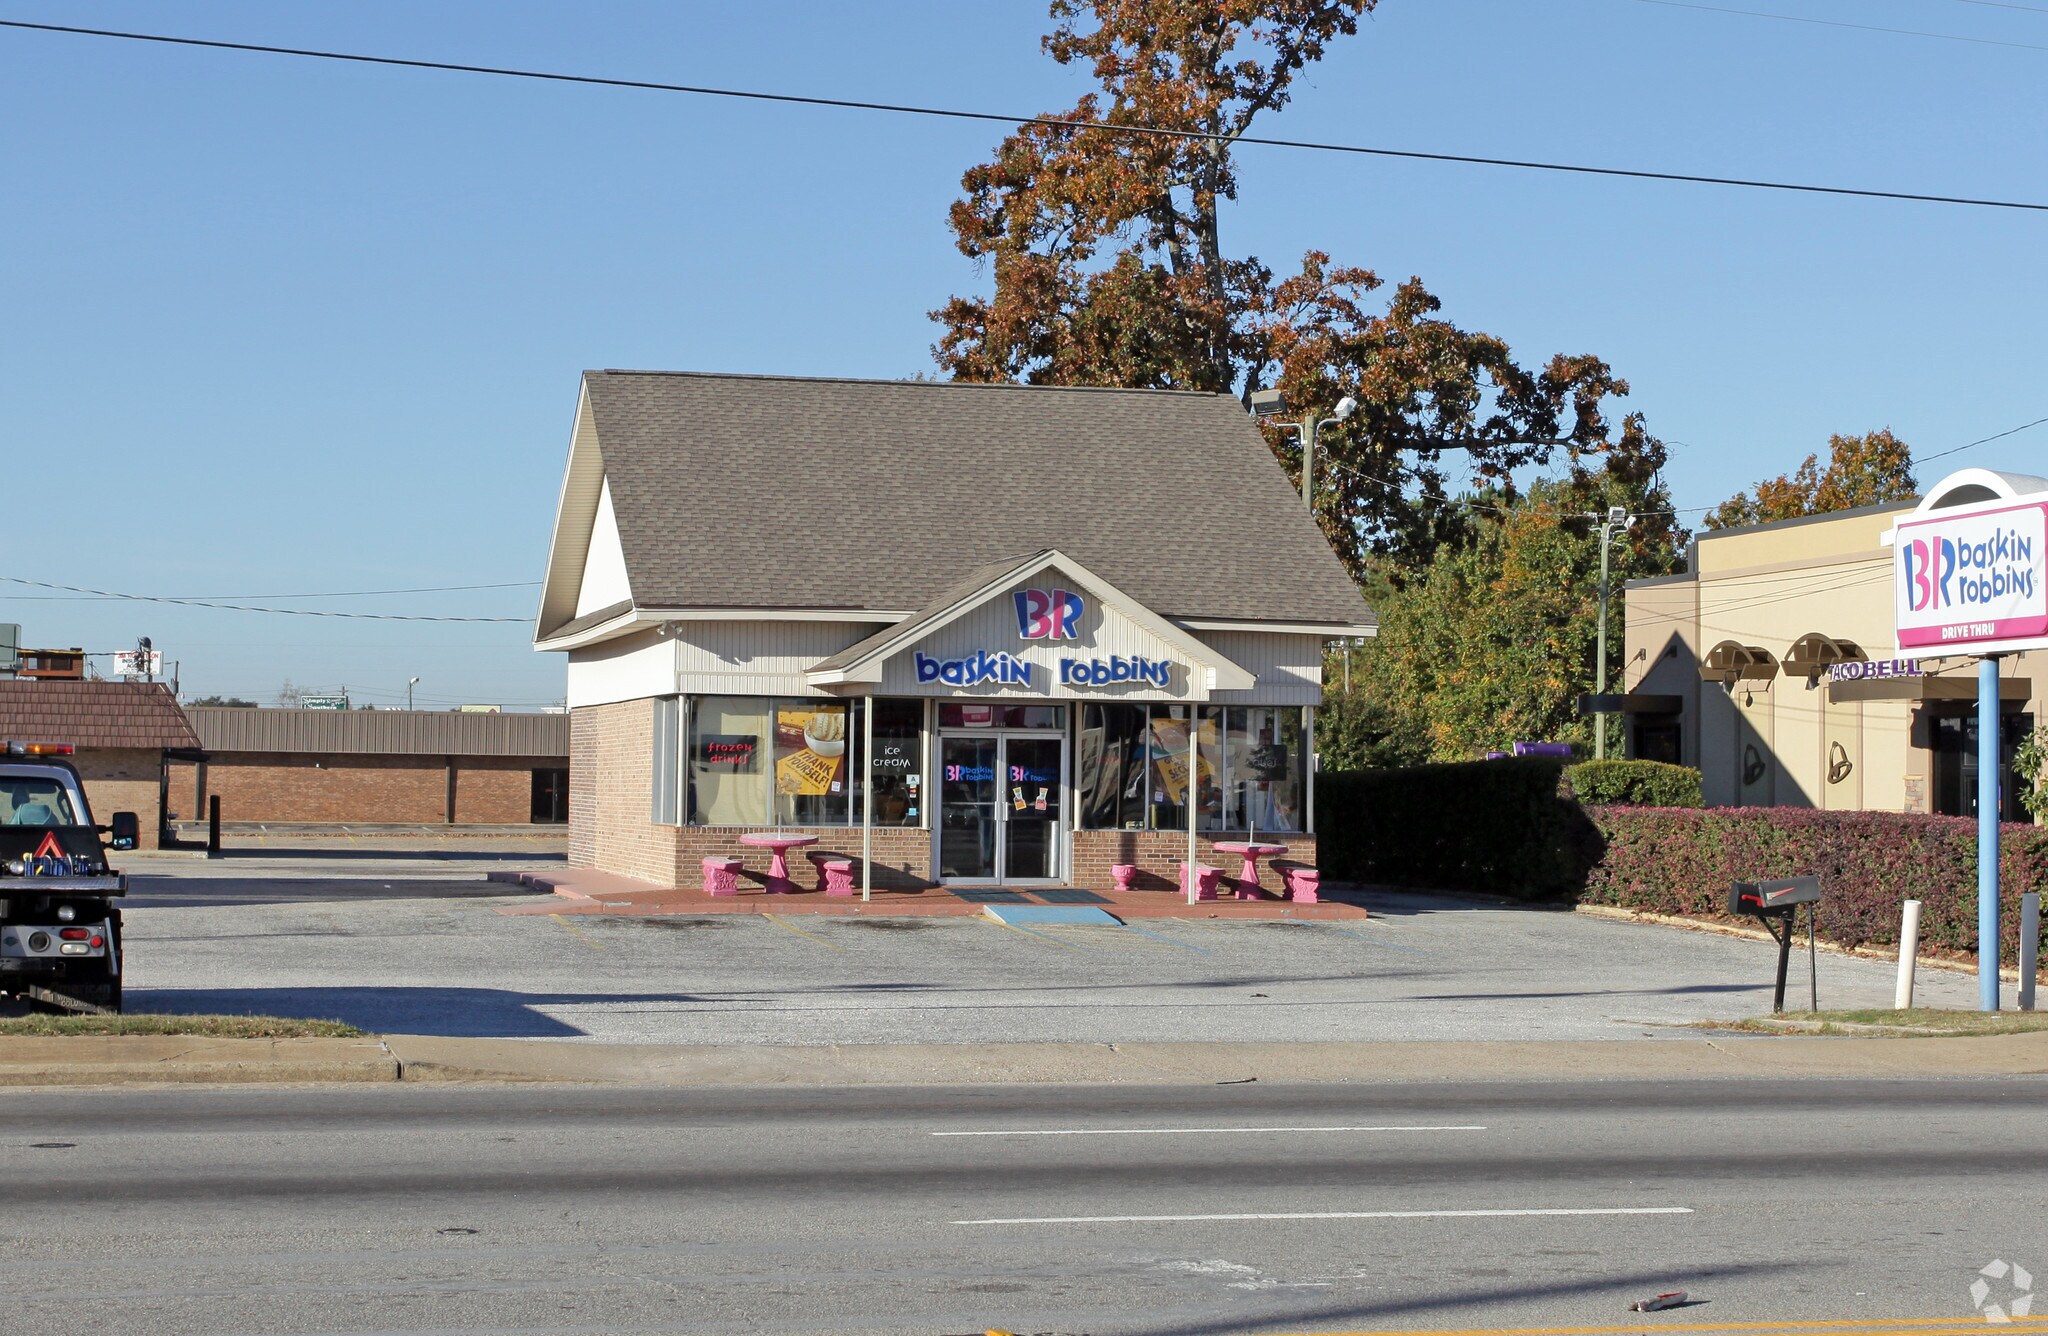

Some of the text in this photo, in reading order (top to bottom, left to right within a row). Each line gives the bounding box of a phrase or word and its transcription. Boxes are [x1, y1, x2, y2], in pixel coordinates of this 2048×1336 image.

[1958, 527, 2031, 570] baskin
[1903, 536, 1956, 611] BR
[1959, 565, 2033, 604] robbins
[1013, 589, 1084, 640] BR
[1942, 622, 1995, 639] DRIVE THRU
[914, 650, 1171, 688] baskin robbins
[1829, 659, 1923, 680] TACO BELL
[708, 741, 753, 752] frozen
[884, 745, 900, 755] ice
[710, 753, 749, 765] drinks
[798, 751, 833, 776] THANK
[873, 758, 911, 768] cream
[965, 766, 993, 775] baskin
[788, 756, 830, 788] YOURSELF!
